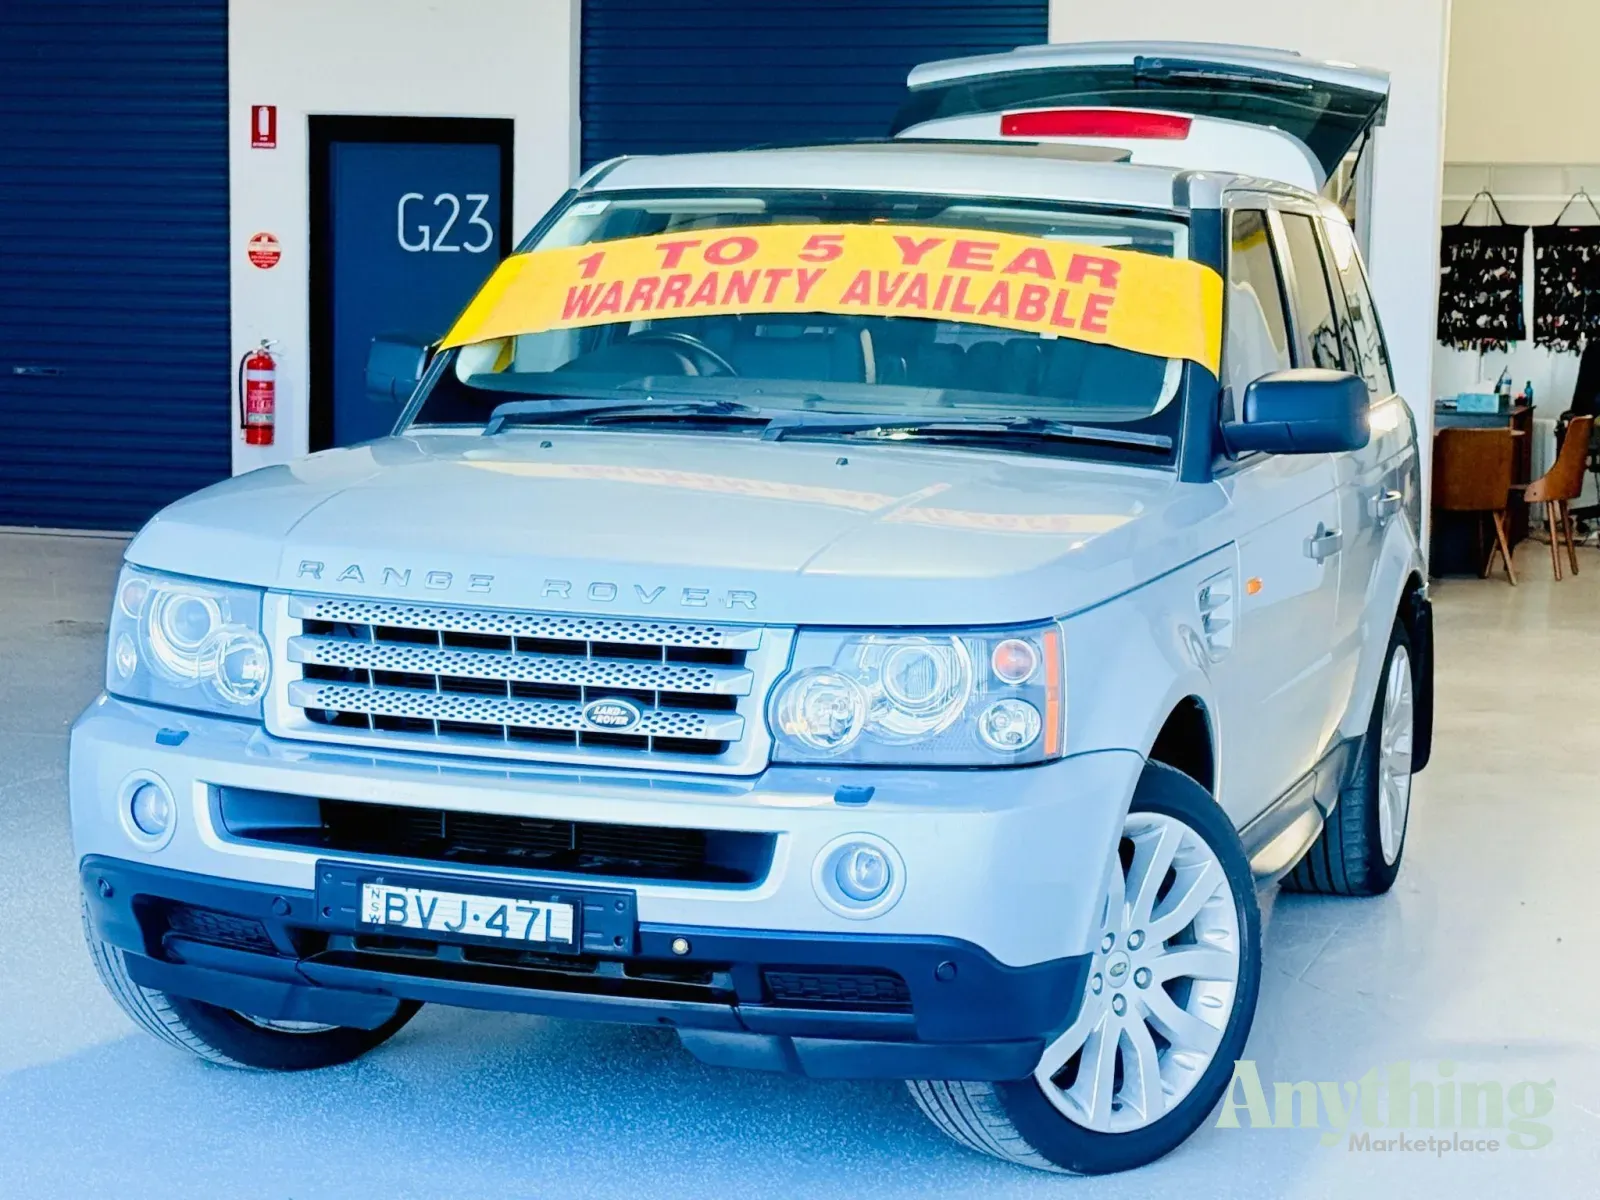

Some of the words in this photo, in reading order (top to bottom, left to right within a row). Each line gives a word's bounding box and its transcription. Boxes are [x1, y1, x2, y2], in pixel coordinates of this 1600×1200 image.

[397, 192, 494, 253] G23
[577, 251, 606, 279] 1
[655, 235, 759, 270] TO
[797, 234, 845, 263] 5
[892, 235, 1122, 290] YEAR
[561, 268, 827, 321] WARRANTY
[839, 270, 1116, 334] AVAILABLE
[298, 559, 495, 594] RANGE
[540, 578, 758, 611] ROVER
[595, 714, 629, 726] ROVER
